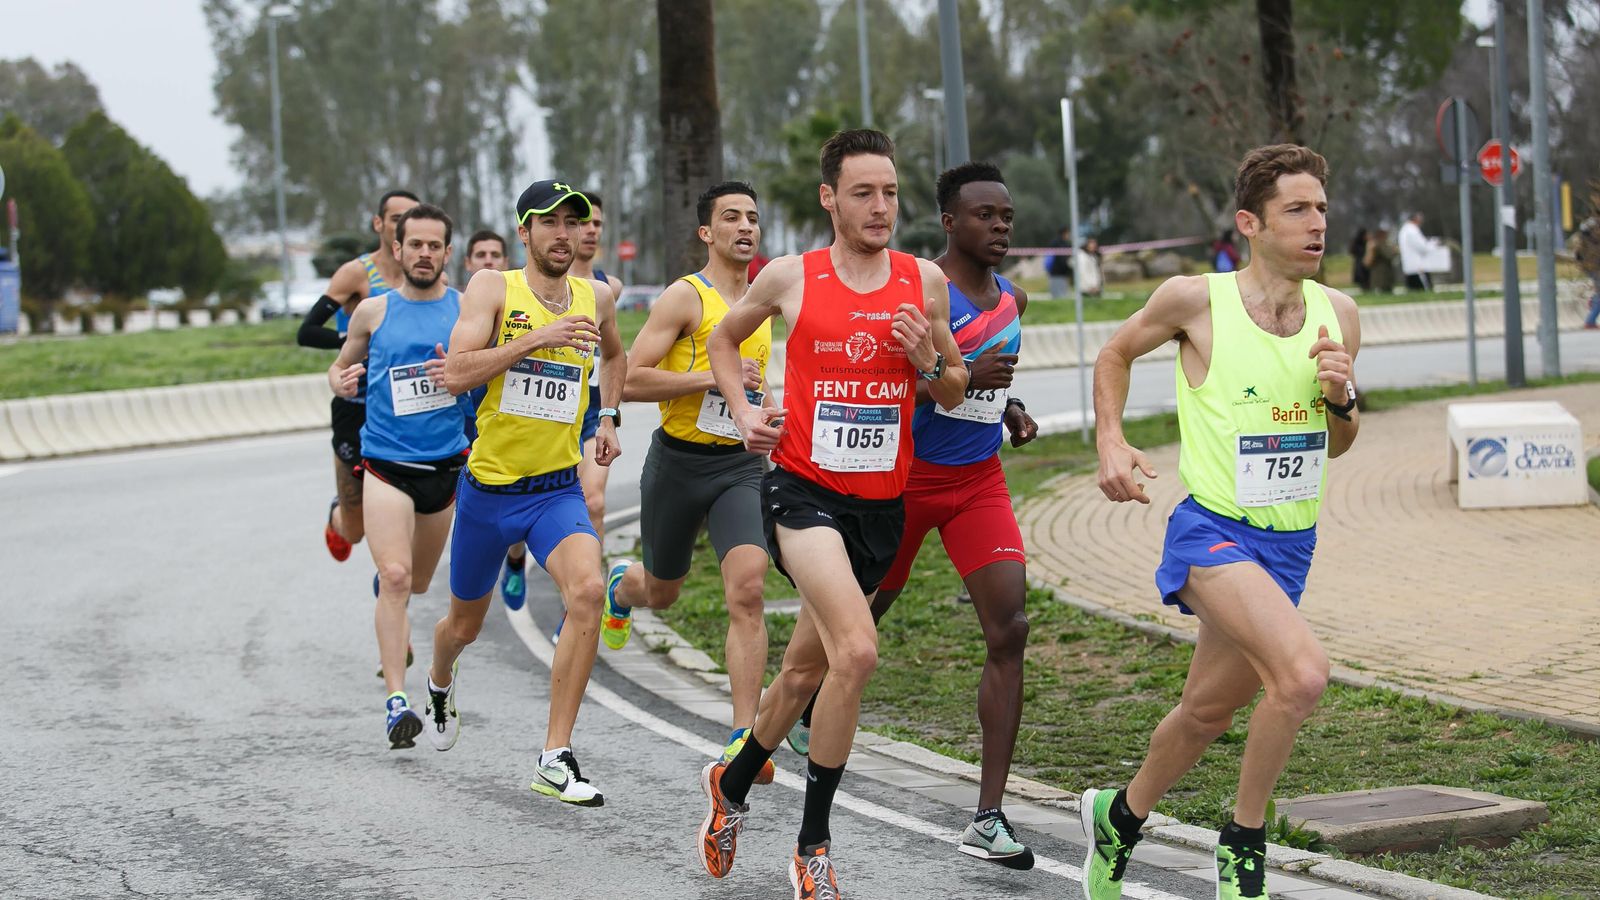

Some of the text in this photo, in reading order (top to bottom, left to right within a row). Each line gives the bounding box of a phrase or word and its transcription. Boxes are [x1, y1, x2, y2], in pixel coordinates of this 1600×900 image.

[1481, 158, 1517, 169] STP
[866, 310, 891, 320] rasán
[505, 320, 533, 330] Vopak
[532, 361, 544, 372] IV
[522, 376, 567, 402] 1108
[813, 379, 909, 400] FENT CAMÍ
[845, 407, 860, 420] IV
[1271, 402, 1308, 421] Barin
[833, 426, 885, 449] 1055
[1267, 436, 1280, 450] IV
[1523, 442, 1567, 458] PABLO
[1265, 455, 1304, 480] 752
[1515, 455, 1576, 470] OLAVIDE
[527, 469, 575, 492] PRO
